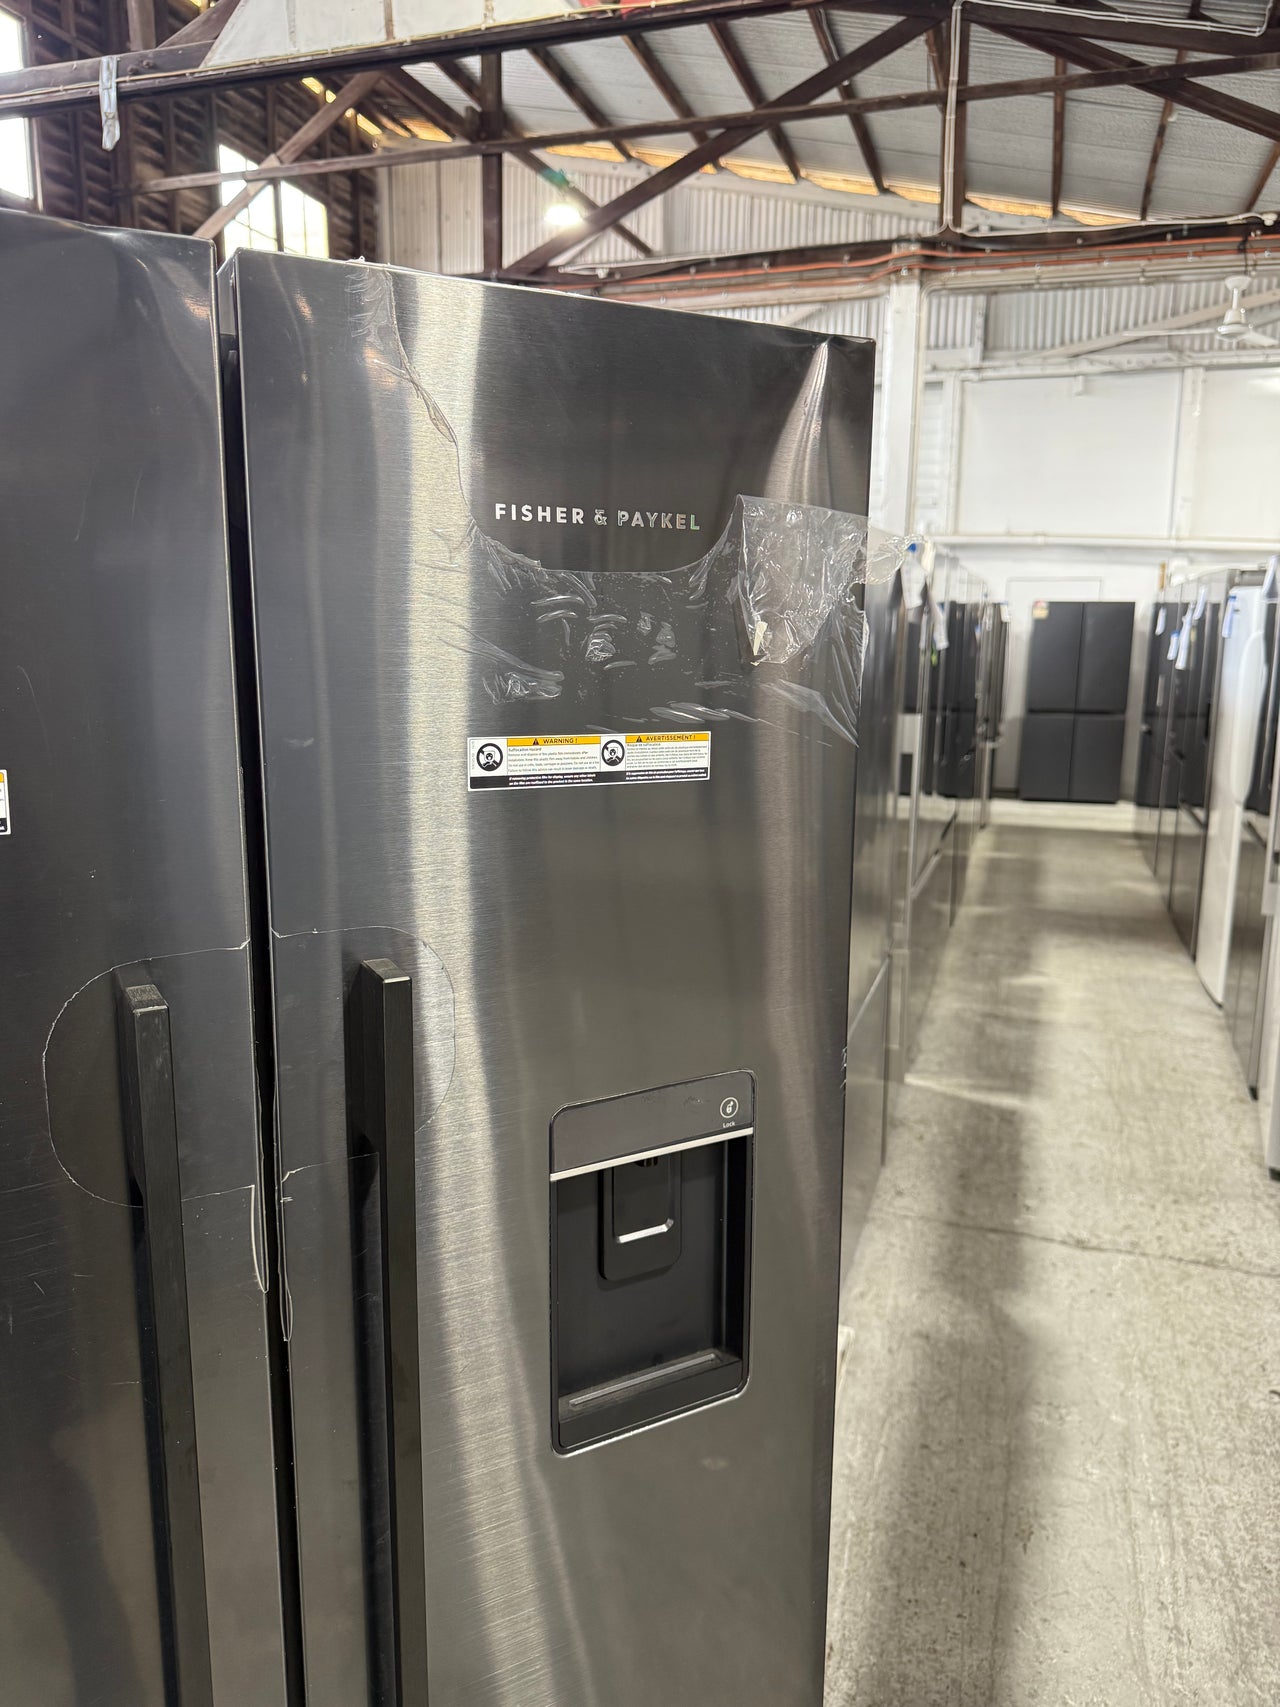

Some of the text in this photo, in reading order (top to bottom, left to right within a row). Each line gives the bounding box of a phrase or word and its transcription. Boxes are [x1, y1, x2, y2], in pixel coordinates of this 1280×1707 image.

[495, 503, 700, 530] FISHER & PAYKEL
